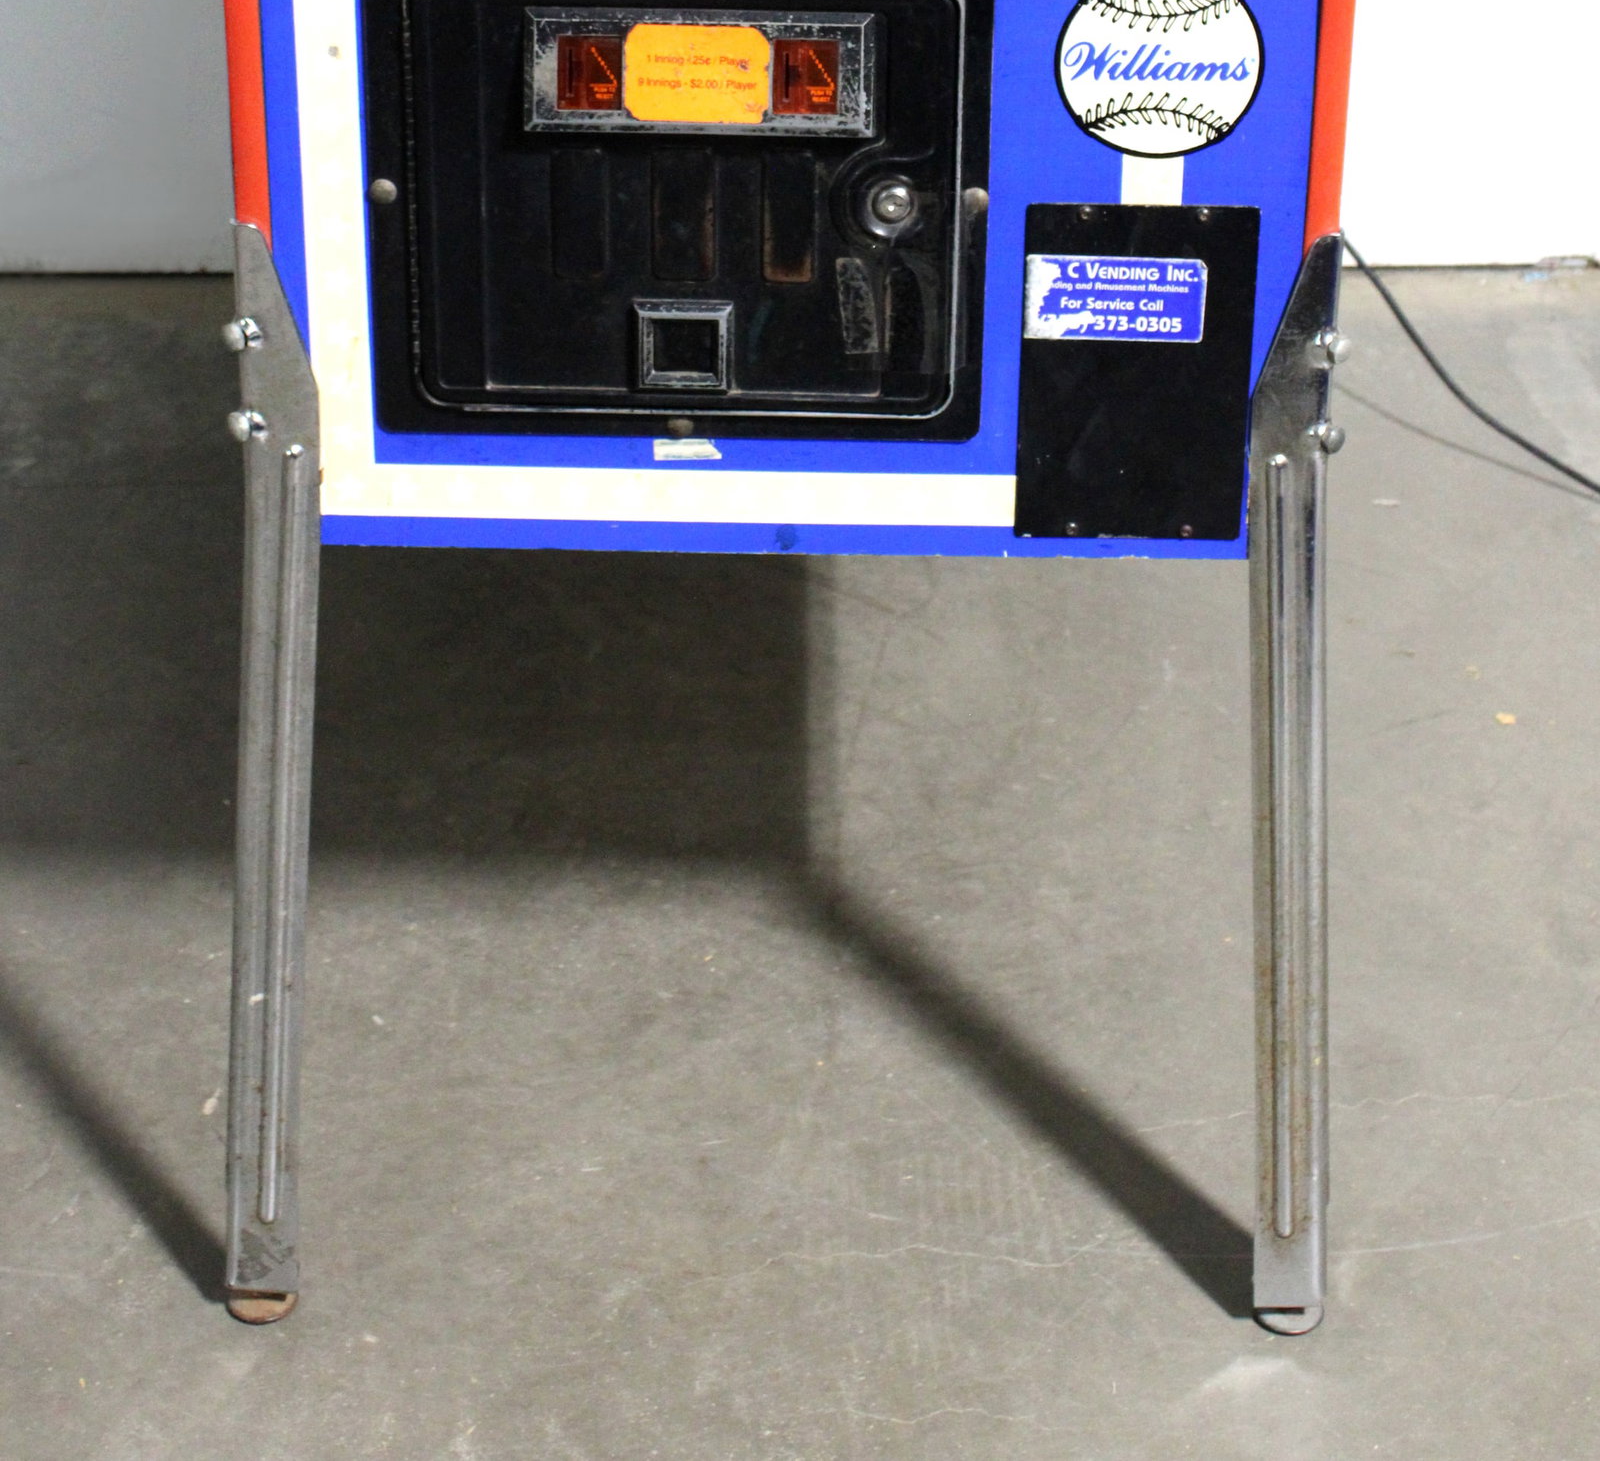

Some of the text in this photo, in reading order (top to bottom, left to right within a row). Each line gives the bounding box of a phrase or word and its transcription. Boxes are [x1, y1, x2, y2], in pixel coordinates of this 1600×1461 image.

[1063, 41, 1250, 81] Williams
[646, 77, 682, 90] Innings
[726, 80, 757, 92] Player
[1067, 262, 1080, 278] C
[1075, 281, 1093, 291] and
[1095, 282, 1146, 292] Amusement
[1148, 284, 1189, 294] Machines
[1060, 296, 1164, 311] For Service Call
[1093, 316, 1182, 333] 373-0305
